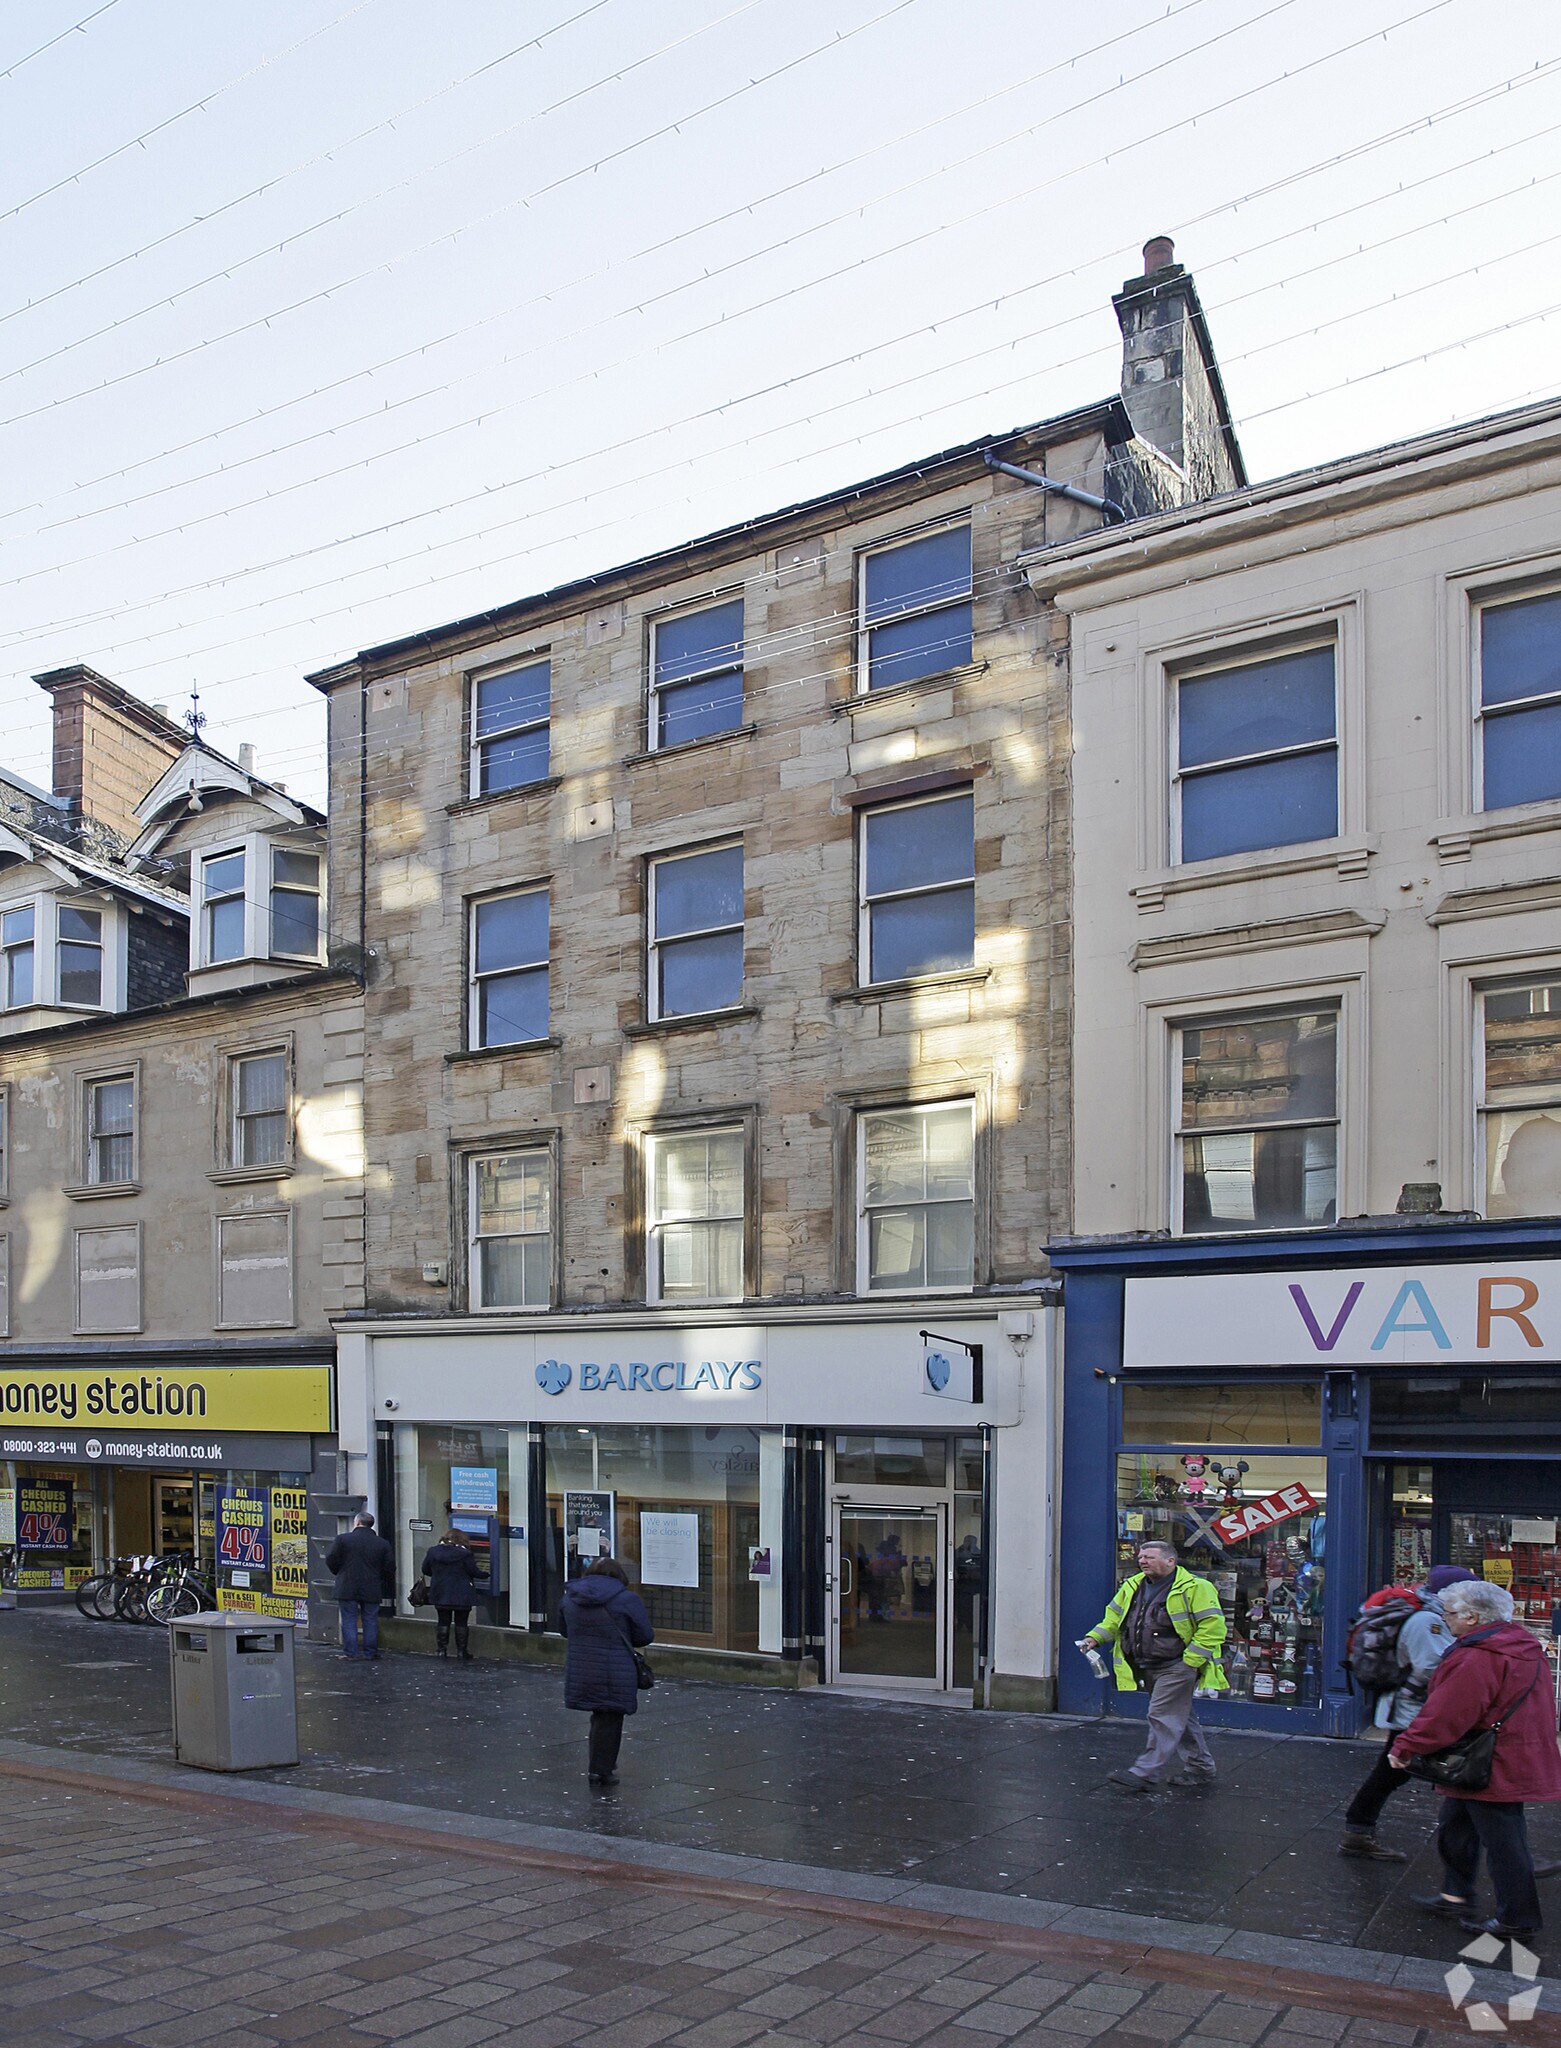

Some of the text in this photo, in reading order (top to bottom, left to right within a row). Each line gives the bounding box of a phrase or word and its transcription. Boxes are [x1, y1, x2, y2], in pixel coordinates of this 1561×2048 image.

[1288, 1276, 1545, 1352] VAR
[579, 1359, 762, 1391] BARCLAYS
[86, 1376, 207, 1416] station
[105, 1441, 223, 1460] money-station.co.uk
[35, 1480, 48, 1489] ALL
[454, 1479, 494, 1487] withdrawals
[21, 1489, 66, 1501] CHEQUES
[235, 1488, 248, 1498] ALL
[568, 1494, 593, 1503] Banking
[21, 1500, 67, 1513] CASHED
[221, 1498, 263, 1513] CHEQUES
[273, 1492, 307, 1510] GOLD
[221, 1511, 264, 1527] CASHED
[282, 1510, 300, 1520] INTO
[568, 1508, 603, 1518] around you
[1219, 1486, 1309, 1540] SALE
[200, 1519, 215, 1528] CHEQ
[273, 1518, 308, 1535] CASH
[646, 1517, 678, 1526] We will
[20, 1513, 67, 1544] 4%
[200, 1527, 215, 1537] CAS
[646, 1527, 692, 1539] be closing
[221, 1526, 265, 1562] 4%
[221, 1560, 242, 1568] INSTANT
[17, 1570, 50, 1579] CHEQUES
[276, 1567, 308, 1584] LOAN
[17, 1578, 50, 1588] CASHED
[222, 1591, 236, 1600] BUY
[242, 1593, 255, 1602] SELL
[262, 1596, 295, 1608] CHEQUES
[223, 1599, 256, 1610] CURRENCY
[262, 1606, 295, 1619] CASHED
[182, 1654, 201, 1664] Litter
[246, 1657, 276, 1665] Litter
